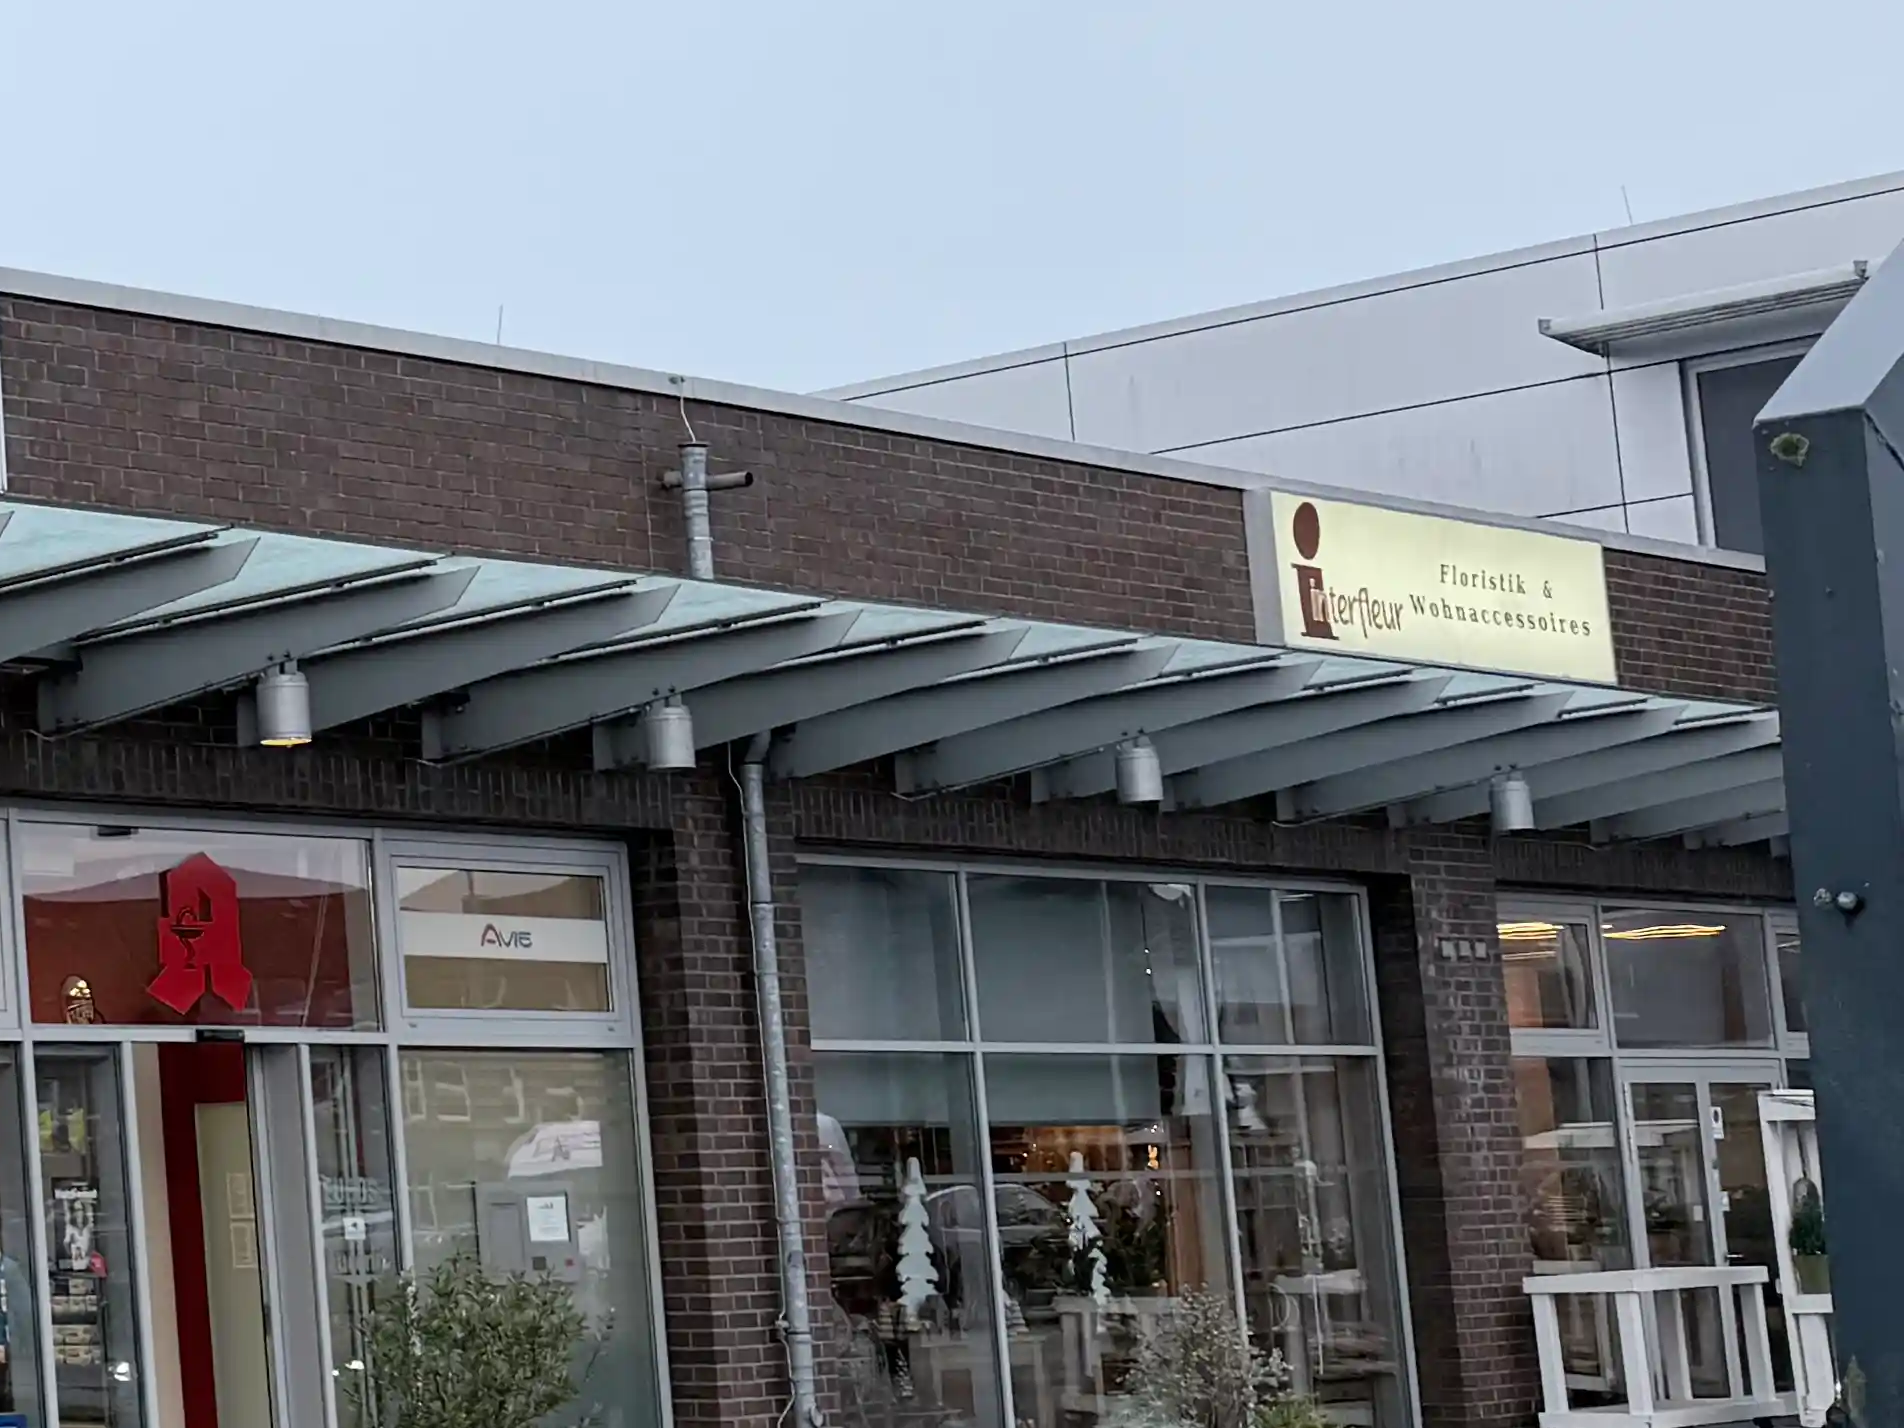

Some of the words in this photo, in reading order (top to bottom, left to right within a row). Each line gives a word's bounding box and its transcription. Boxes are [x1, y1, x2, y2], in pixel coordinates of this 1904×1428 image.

[1439, 564, 1527, 596] Floristik
[1542, 580, 1553, 599] &
[1409, 593, 1592, 637] Wohnaccessoires
